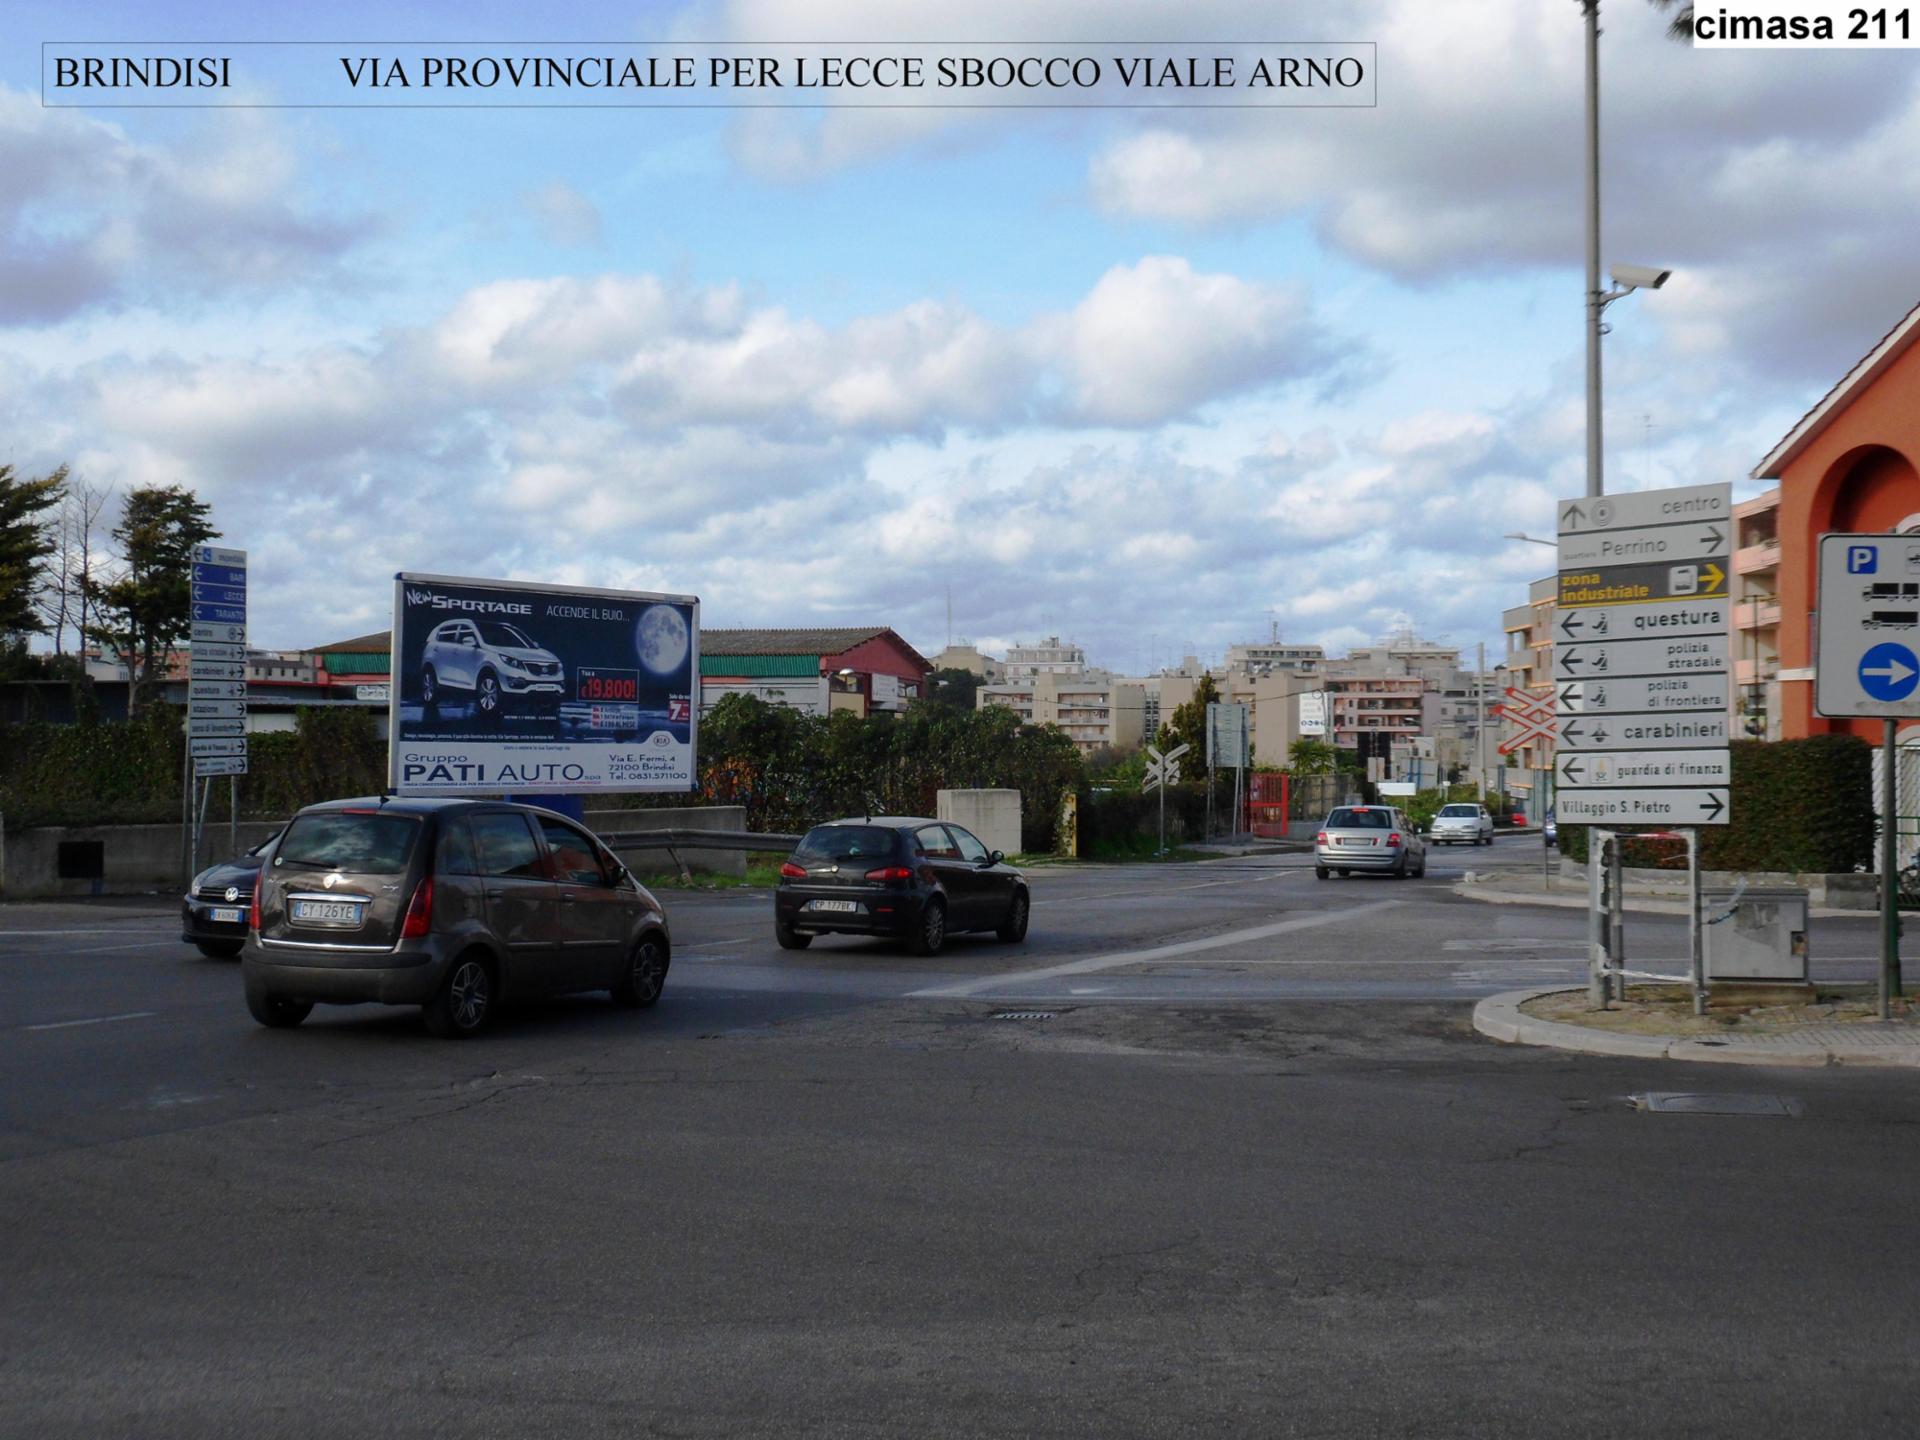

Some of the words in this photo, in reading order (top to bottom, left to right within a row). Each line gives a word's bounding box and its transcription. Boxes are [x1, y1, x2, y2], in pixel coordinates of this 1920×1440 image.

[1661, 497, 1721, 514] centro
[1601, 538, 1668, 557] Perrino
[1561, 573, 1601, 586] zona
[1562, 584, 1649, 602] industriale
[406, 590, 432, 607] New
[431, 595, 533, 615] SPORTAGE
[546, 604, 590, 619] ACCENDE
[591, 607, 600, 620] IL
[1634, 610, 1721, 631] questura
[1667, 642, 1709, 655] polizia
[1667, 657, 1722, 668] stradale
[1647, 680, 1689, 692] polizia
[1648, 696, 1660, 707] di
[1664, 694, 1722, 707] frontiera
[1624, 721, 1724, 740] carabinieri
[405, 753, 468, 763] Gruppo
[609, 754, 624, 762] Via
[627, 754, 637, 762] E.
[404, 764, 485, 782] PATI
[497, 764, 584, 781] AUTO
[642, 763, 674, 771] Brindisi
[1617, 764, 1661, 779] guardia
[1665, 764, 1675, 775] di
[1680, 763, 1724, 775] finanza
[609, 772, 626, 780] Tel.
[1562, 801, 1617, 816] Villaggio
[1620, 801, 1631, 813] S.
[1634, 801, 1671, 813] Pietro
